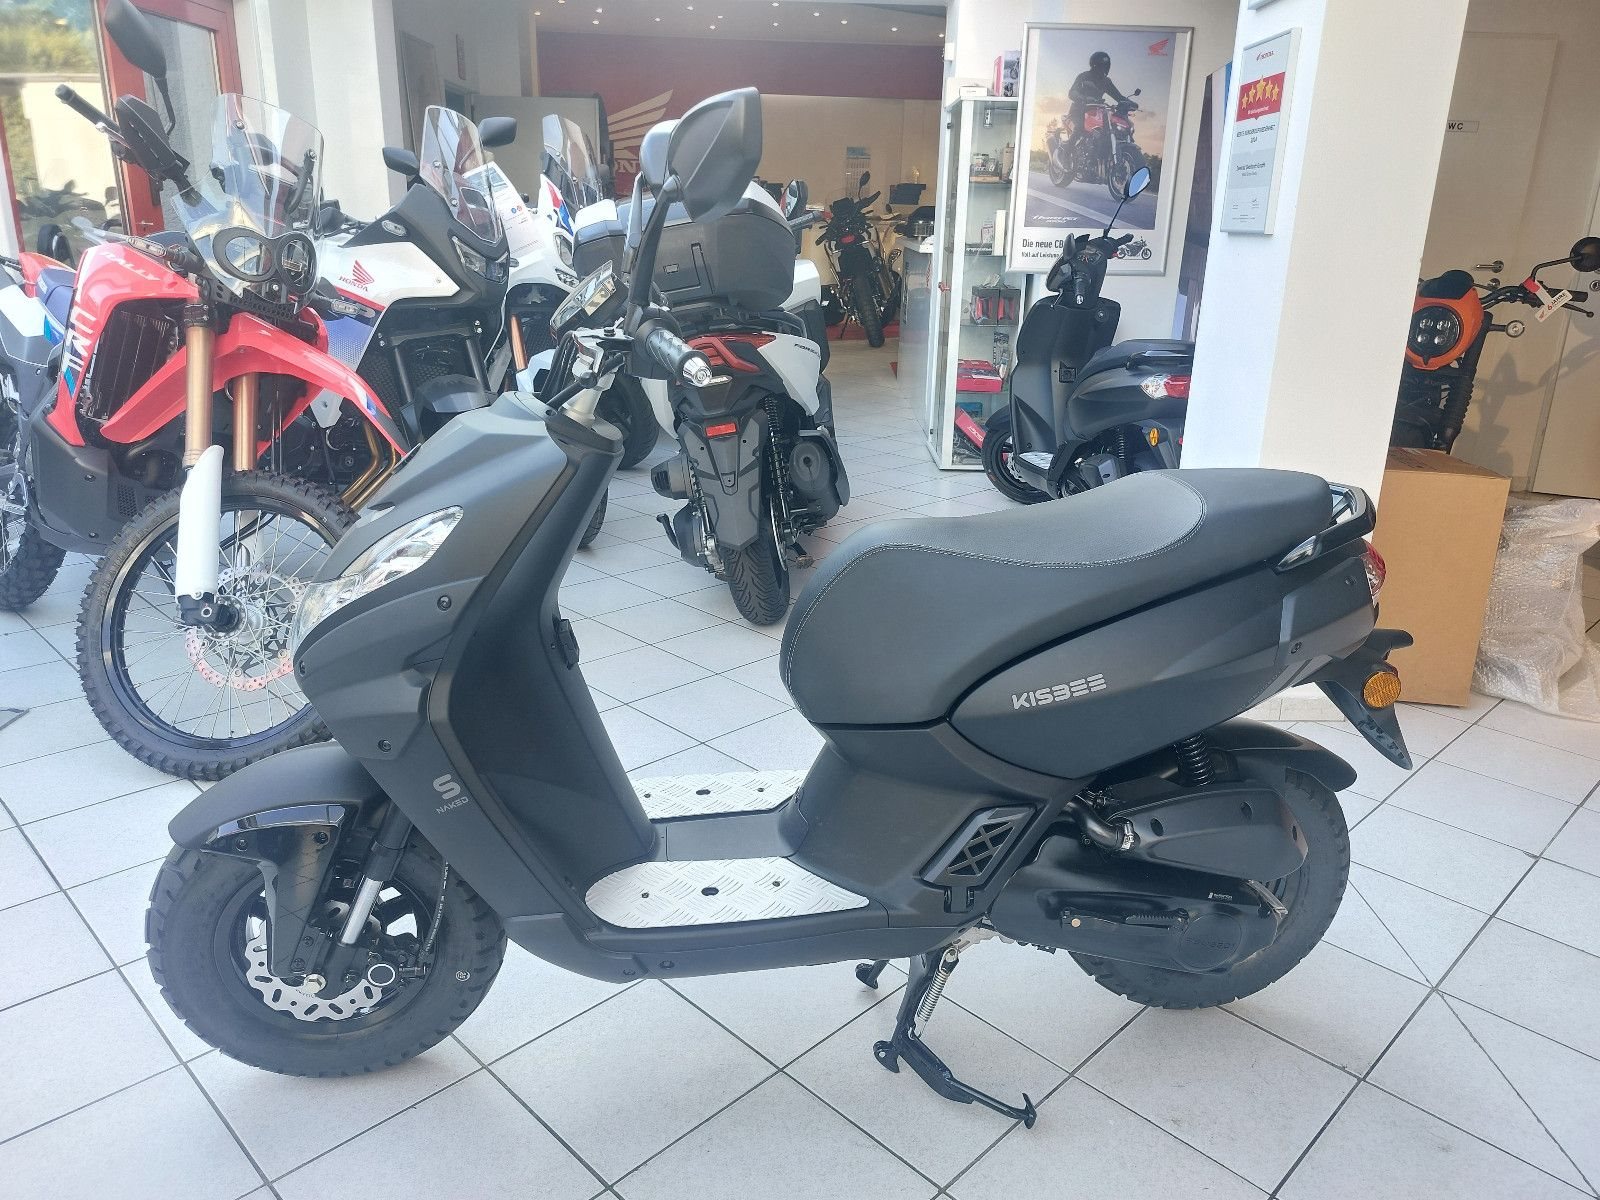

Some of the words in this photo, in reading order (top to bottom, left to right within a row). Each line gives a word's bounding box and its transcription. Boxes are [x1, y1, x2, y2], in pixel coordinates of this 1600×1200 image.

[1448, 122, 1464, 130] WC
[1022, 238, 1034, 248] Die
[1035, 241, 1053, 249] neue
[100, 252, 160, 281] RALLY
[339, 275, 369, 292] HONDA
[1011, 673, 1107, 710] KISBEE
[432, 773, 461, 800] S
[435, 796, 469, 814] NAKED
